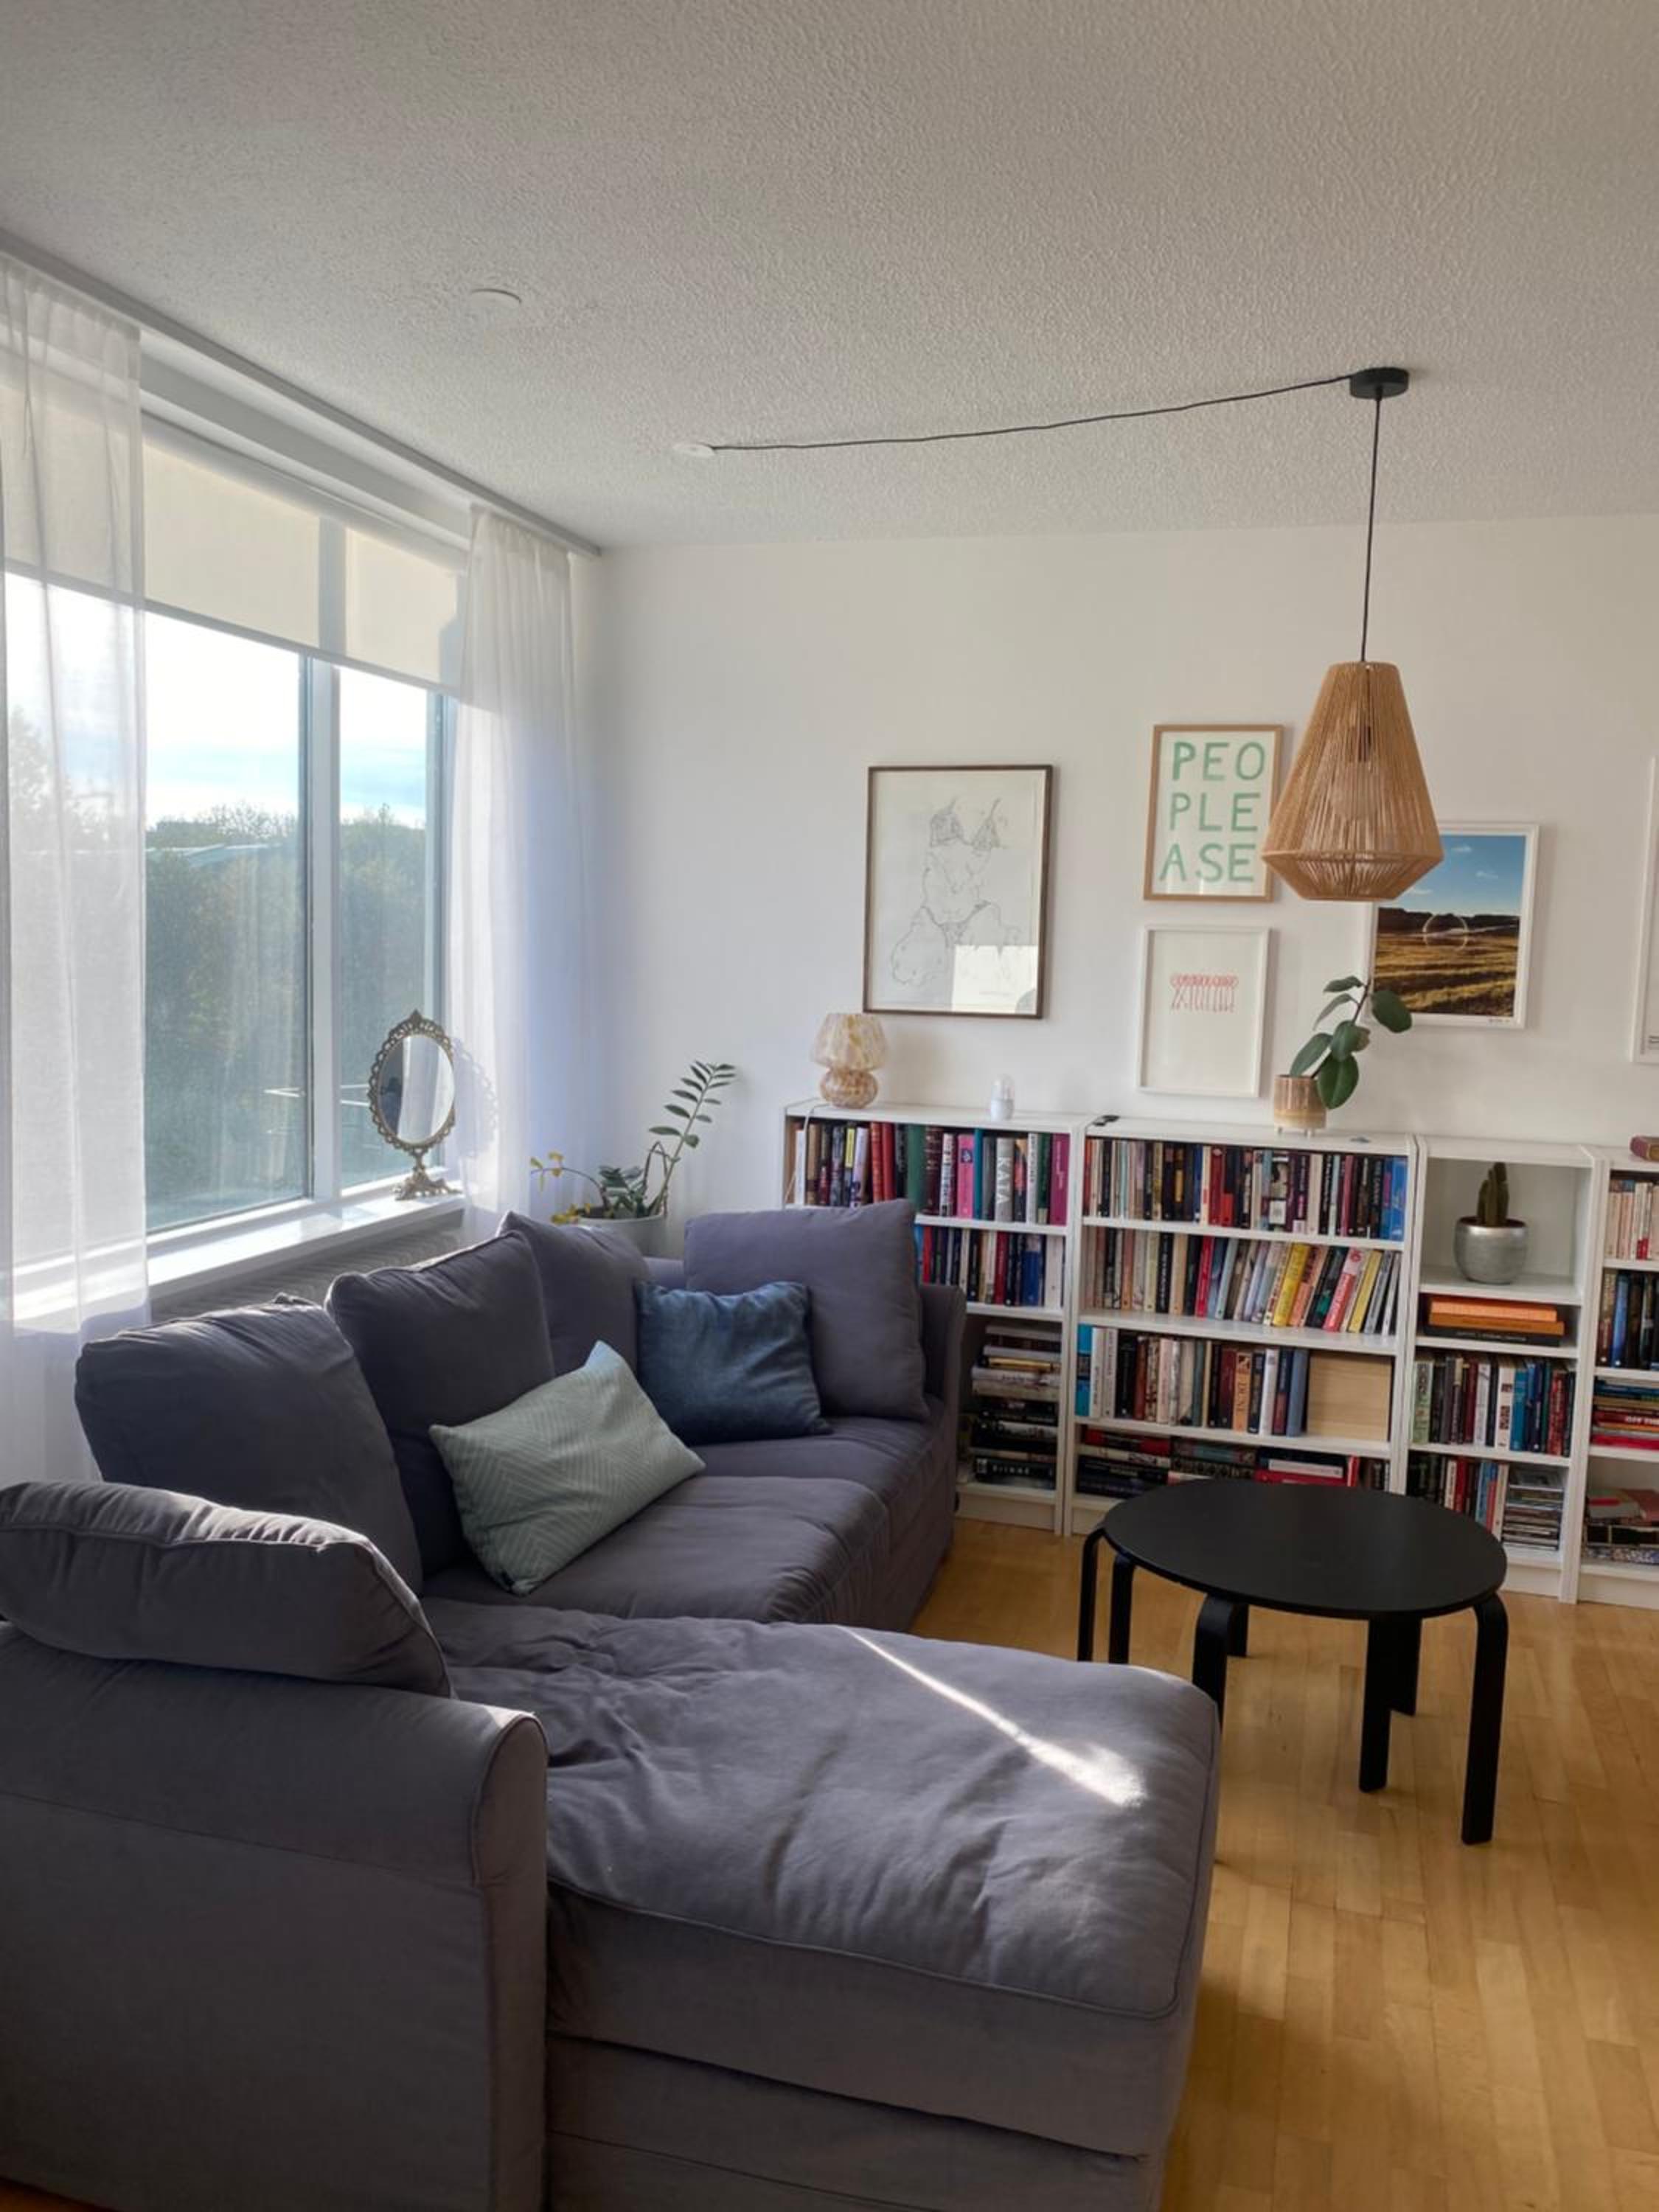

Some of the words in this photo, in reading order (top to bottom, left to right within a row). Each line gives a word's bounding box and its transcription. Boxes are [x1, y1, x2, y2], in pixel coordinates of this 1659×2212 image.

[1172, 740, 1265, 782] PEO
[1169, 792, 1261, 832] PLE
[1158, 842, 1256, 883] ASE
[995, 1157, 1011, 1204] KATA
